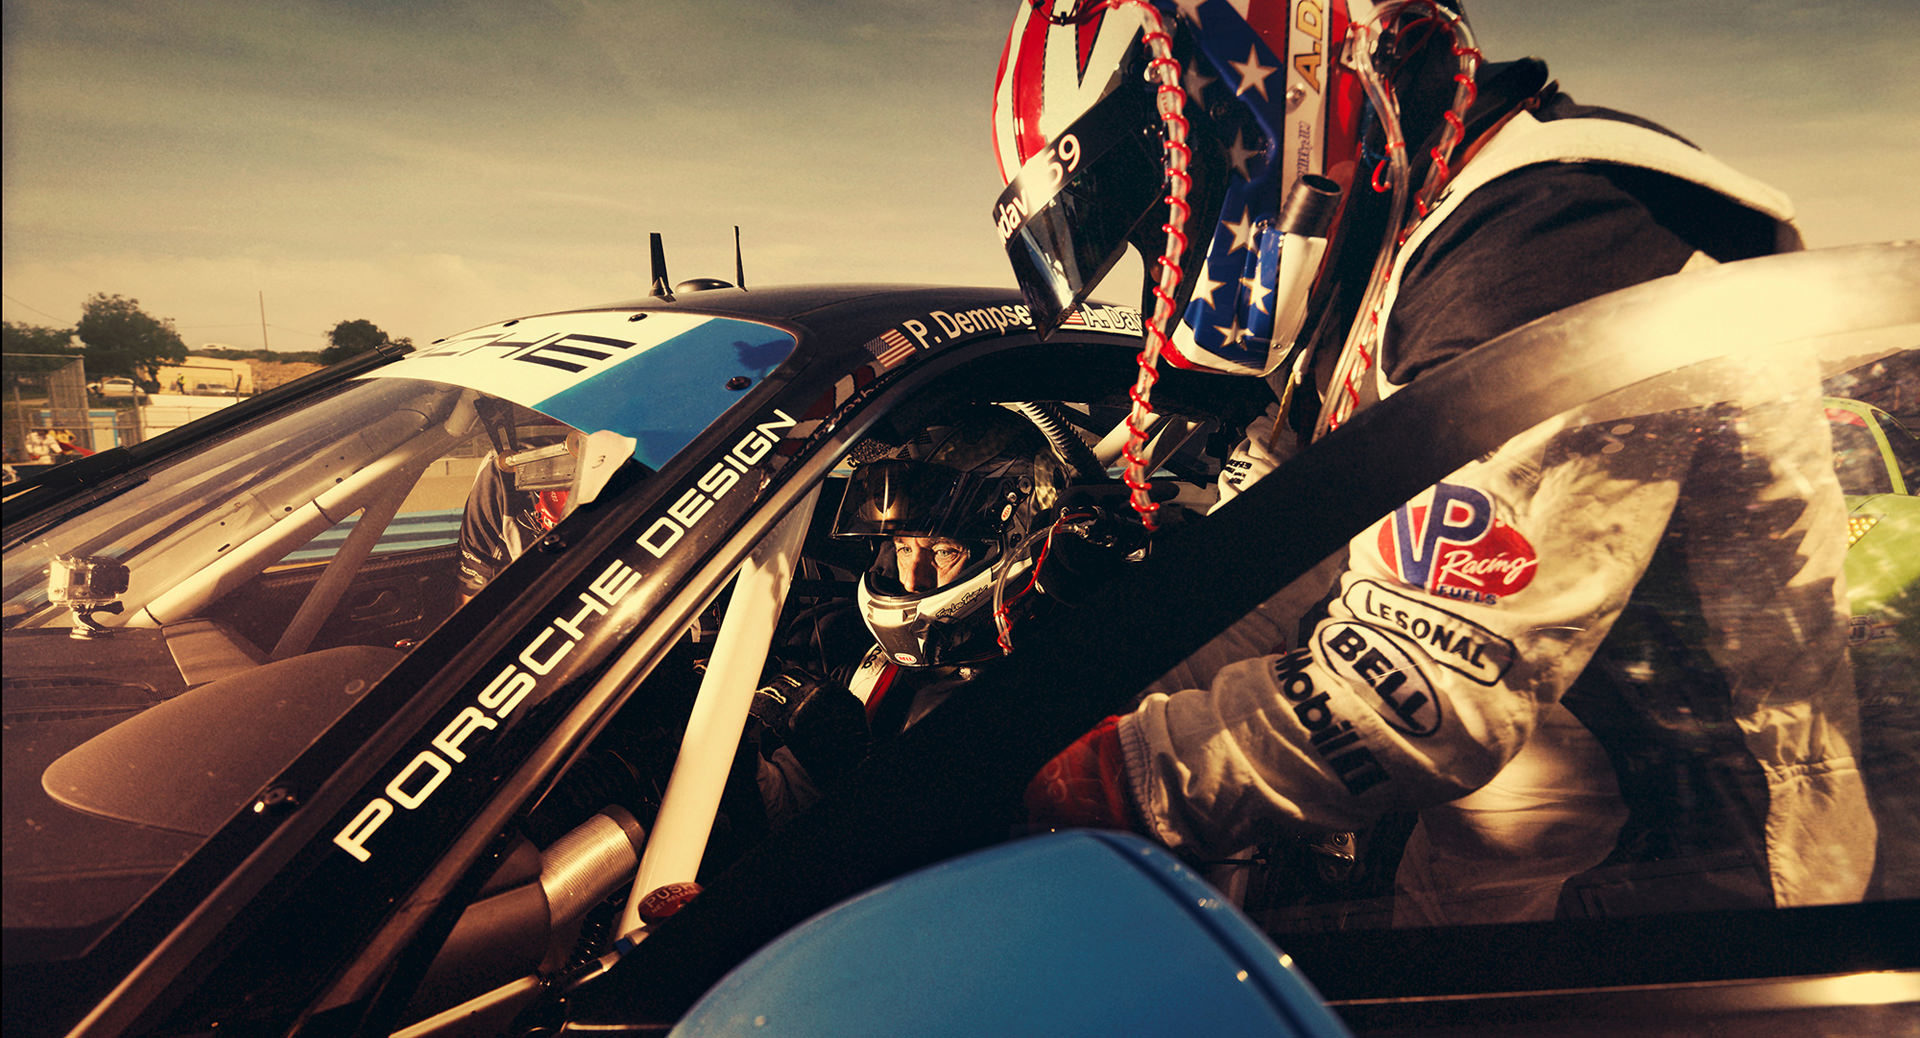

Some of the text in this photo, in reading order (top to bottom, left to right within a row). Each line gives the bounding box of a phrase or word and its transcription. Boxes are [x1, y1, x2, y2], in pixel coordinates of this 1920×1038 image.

[1041, 133, 1081, 191] 59
[902, 303, 1033, 350] P. Dempse
[1394, 481, 1495, 590] VP
[1439, 549, 1540, 586] Racing
[333, 559, 643, 863] PORSCHE
[636, 408, 798, 560] DESIGN
[1437, 585, 1498, 606] FUELS
[1274, 647, 1361, 757] Mobil
[1326, 626, 1429, 732] BELL
